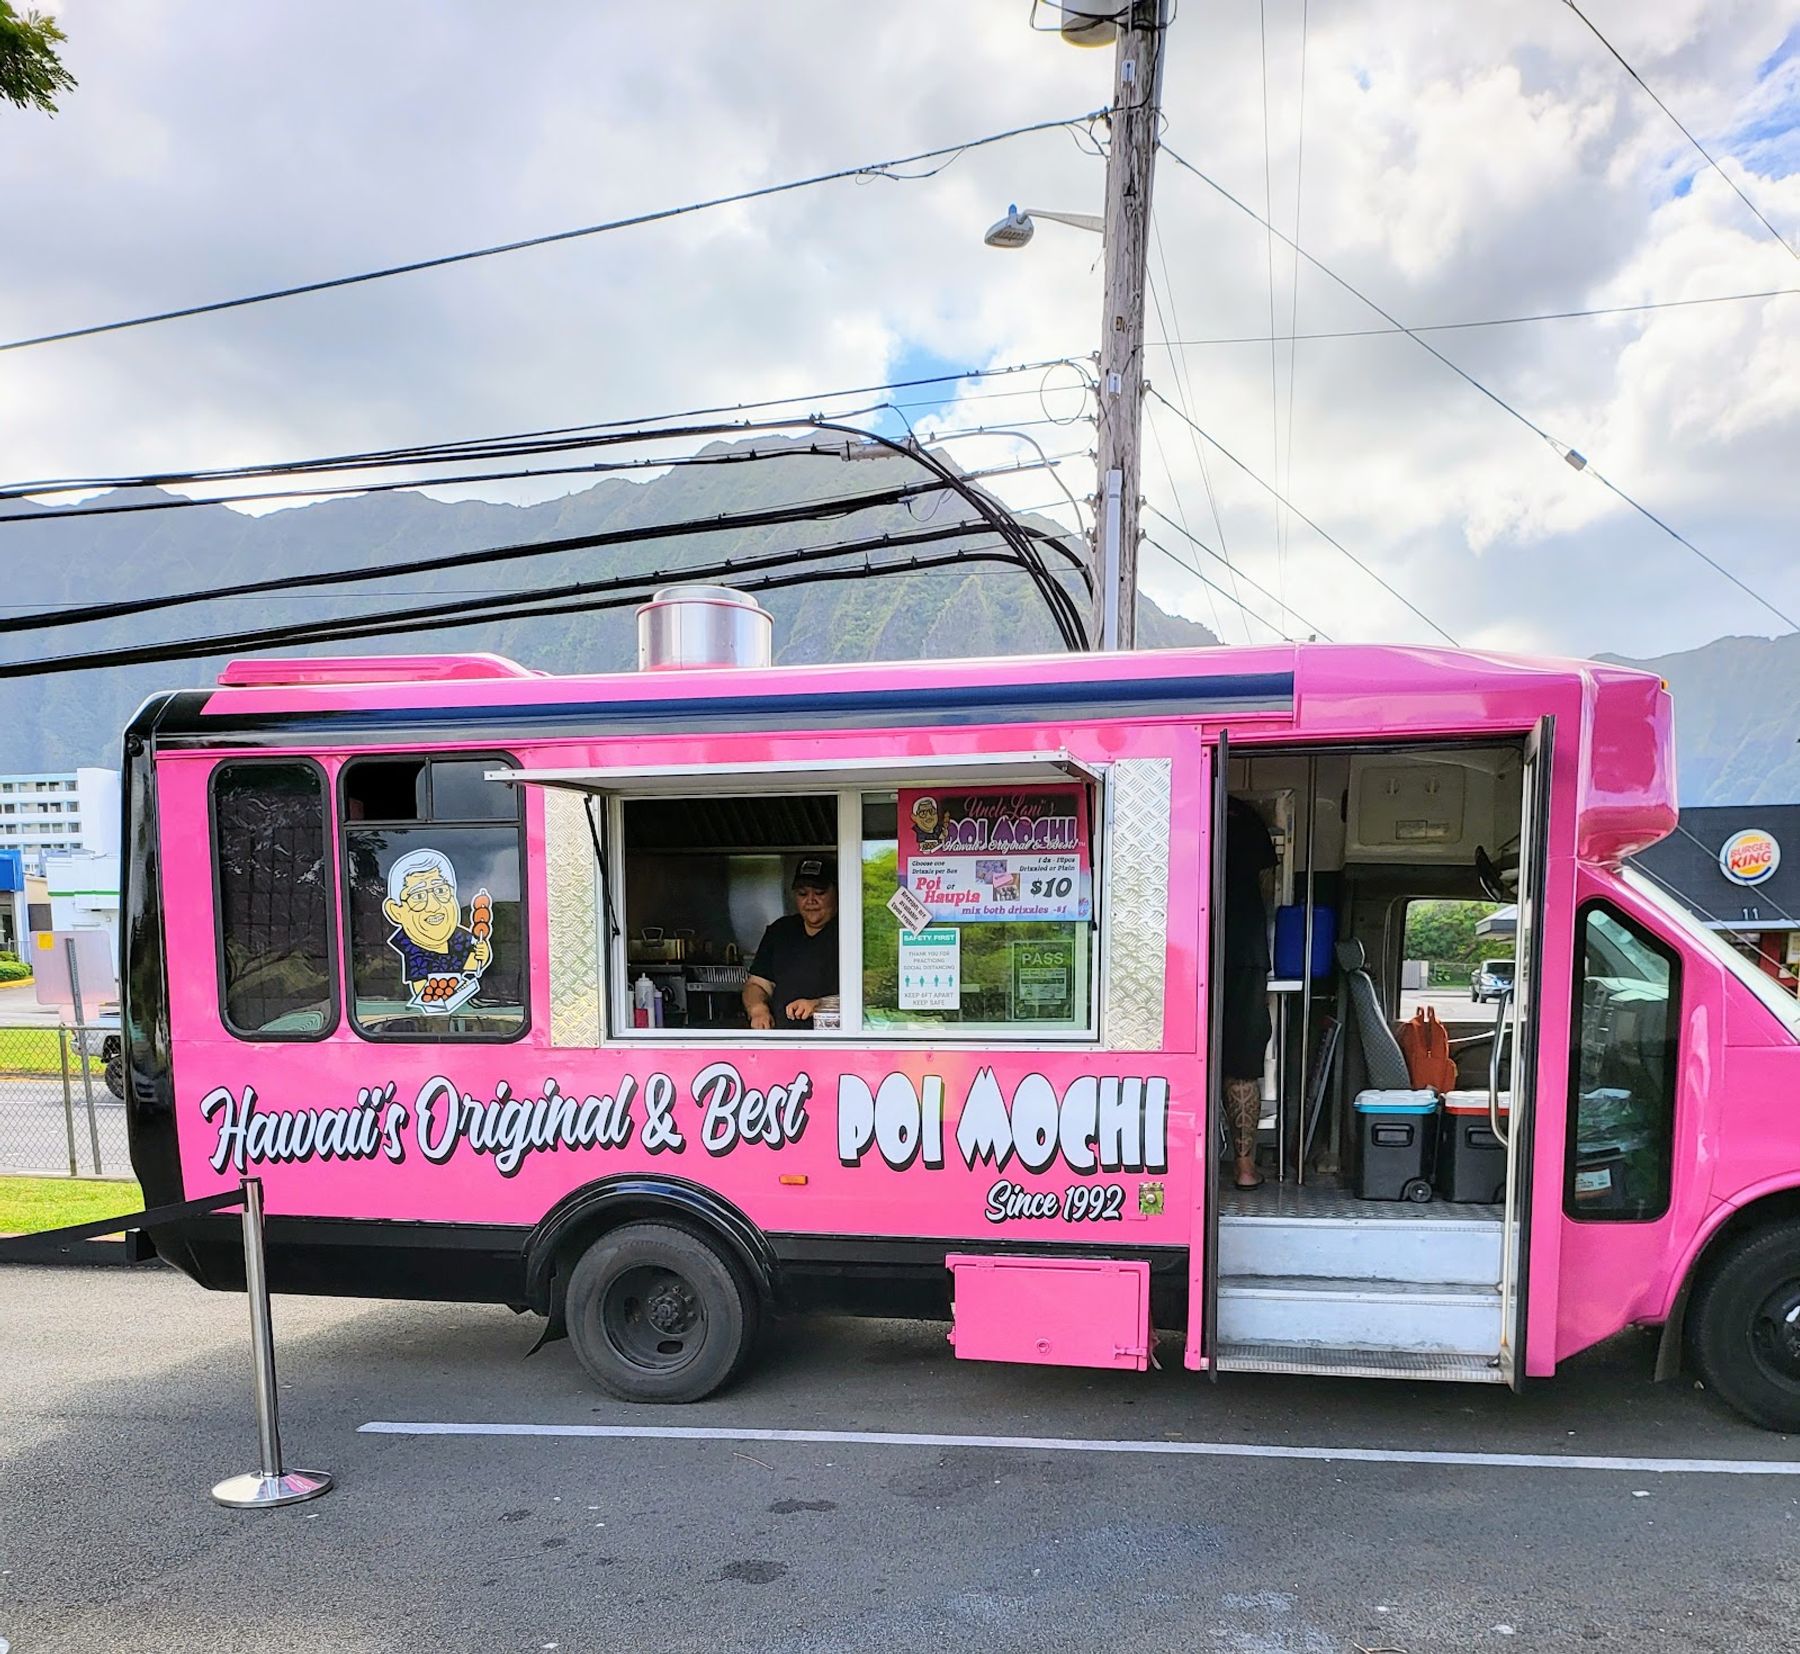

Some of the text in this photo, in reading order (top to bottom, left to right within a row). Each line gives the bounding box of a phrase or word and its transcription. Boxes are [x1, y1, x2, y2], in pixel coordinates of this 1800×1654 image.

[963, 796, 1005, 818] Uncle
[990, 814, 1078, 844] MOCHI
[987, 839, 1033, 854] Original
[1730, 842, 1772, 869] BURGER KING
[915, 876, 941, 890] Poi
[1030, 876, 1073, 898] $10
[923, 889, 981, 907] Haupia
[962, 906, 982, 914] mix
[983, 904, 1006, 914] both
[1008, 904, 1049, 914] drizzles
[1021, 952, 1064, 965] PASS
[201, 1061, 812, 1178] Hawaii's Original & Best
[838, 1065, 1171, 1177] POI MOCHI
[985, 1179, 1126, 1223] Since 1992
